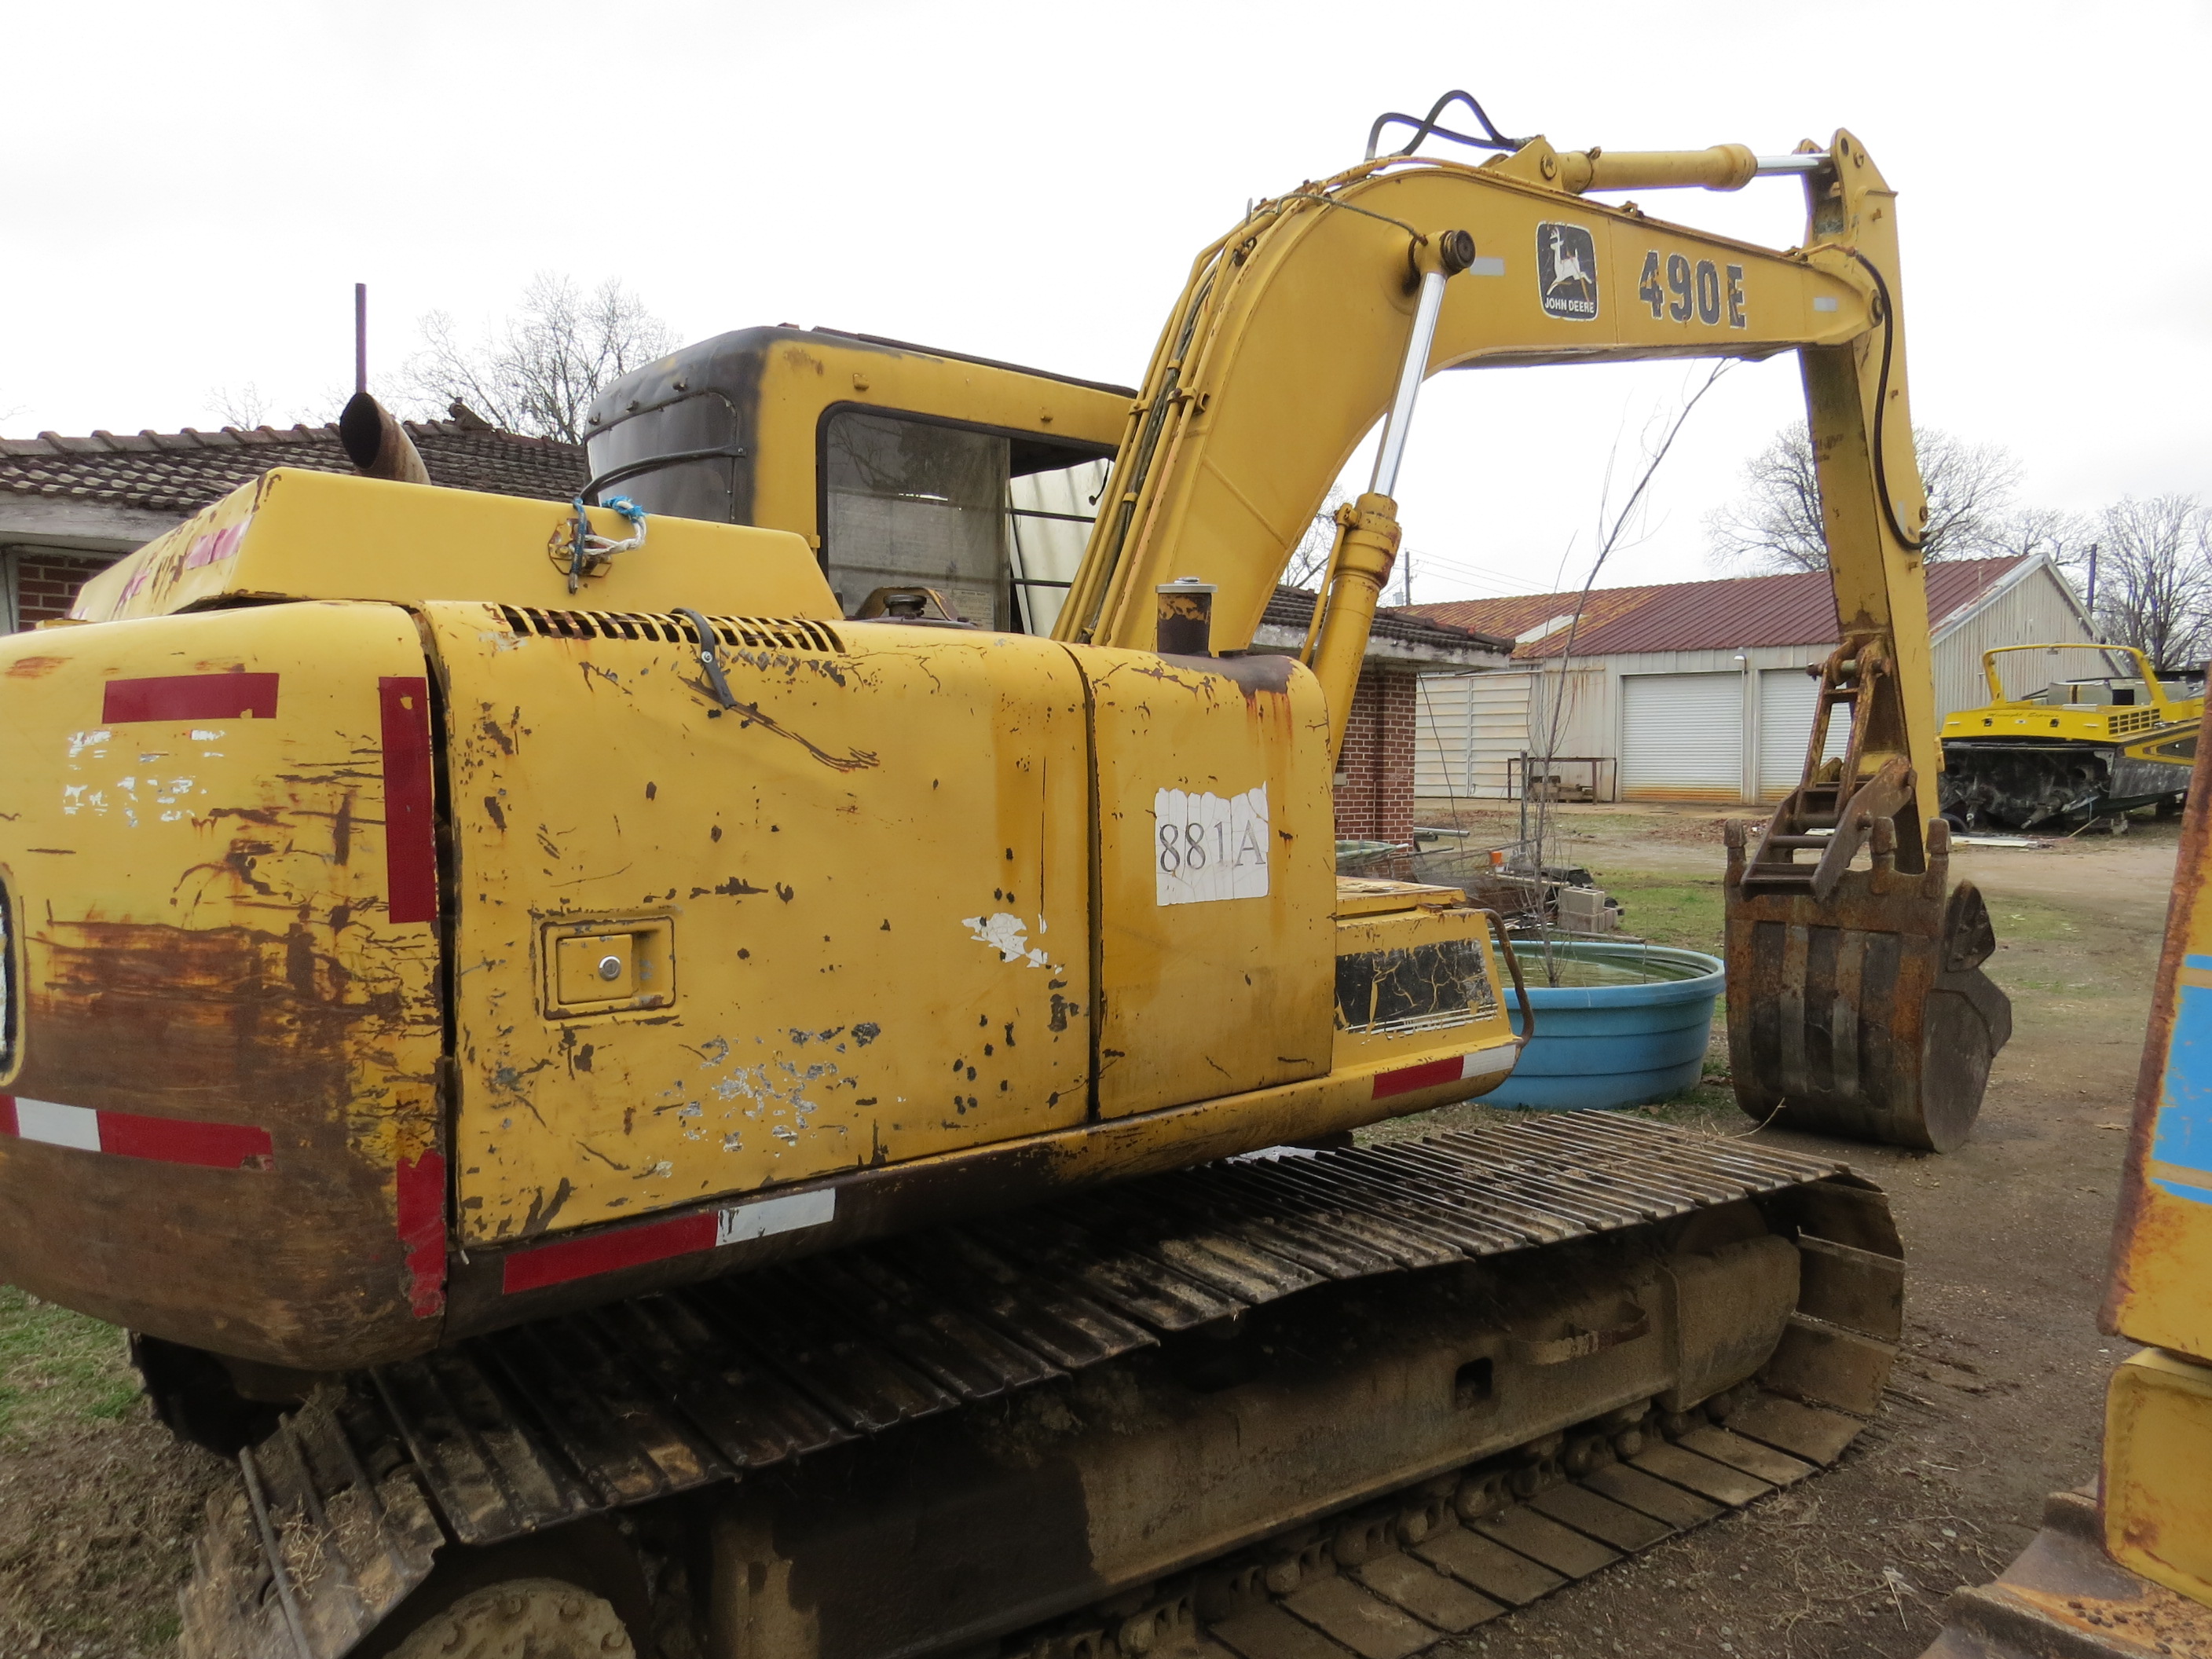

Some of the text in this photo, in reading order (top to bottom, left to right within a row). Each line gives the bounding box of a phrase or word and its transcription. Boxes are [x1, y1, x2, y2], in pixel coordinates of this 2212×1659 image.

[1544, 297, 1595, 313] JOHN DEERE
[1159, 820, 1266, 872] 881A
